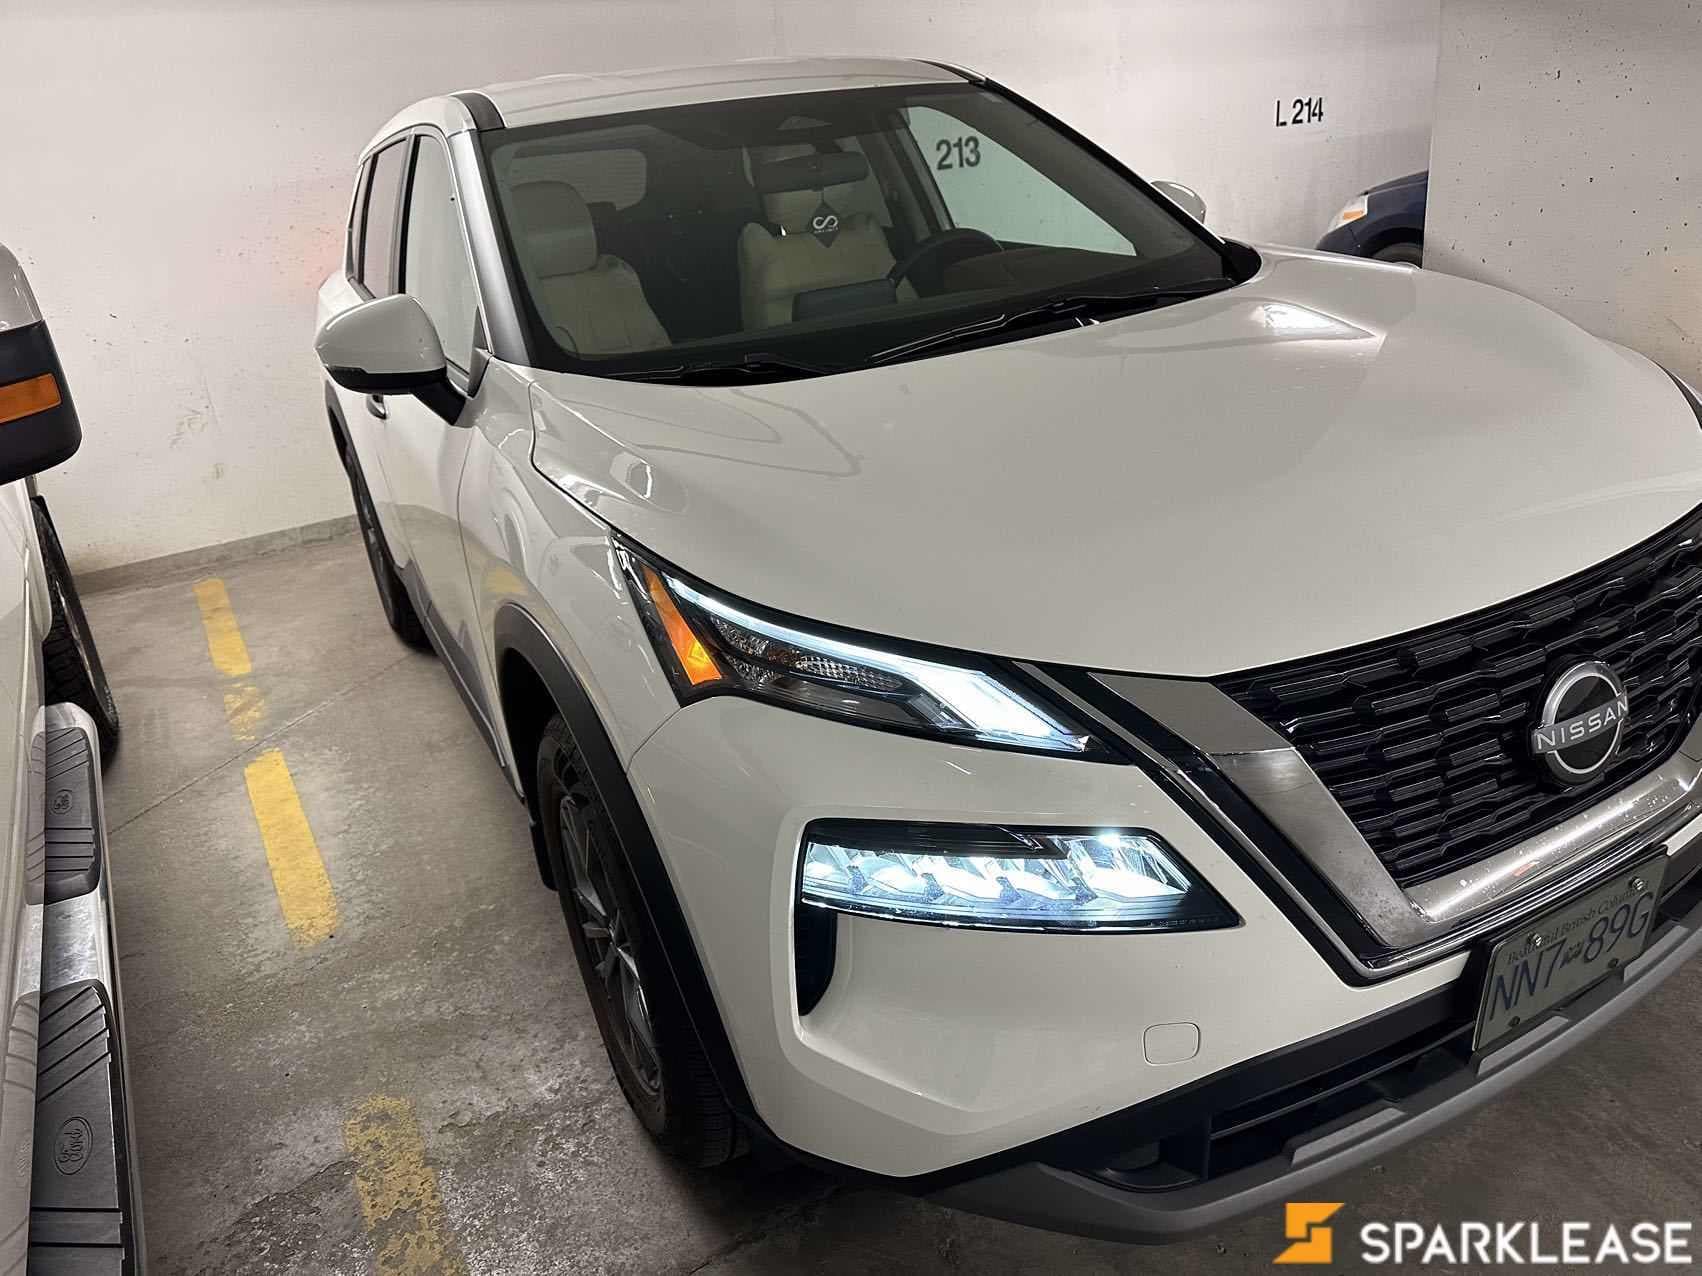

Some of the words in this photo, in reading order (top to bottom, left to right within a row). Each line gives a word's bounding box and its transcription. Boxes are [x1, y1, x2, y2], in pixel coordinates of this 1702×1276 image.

[1276, 99, 1287, 127] L
[1292, 97, 1324, 124] 214
[935, 135, 981, 171] 213
[1536, 695, 1629, 750] NISSAN
[1489, 936, 1567, 1021] NN7
[1583, 891, 1654, 964] 89G
